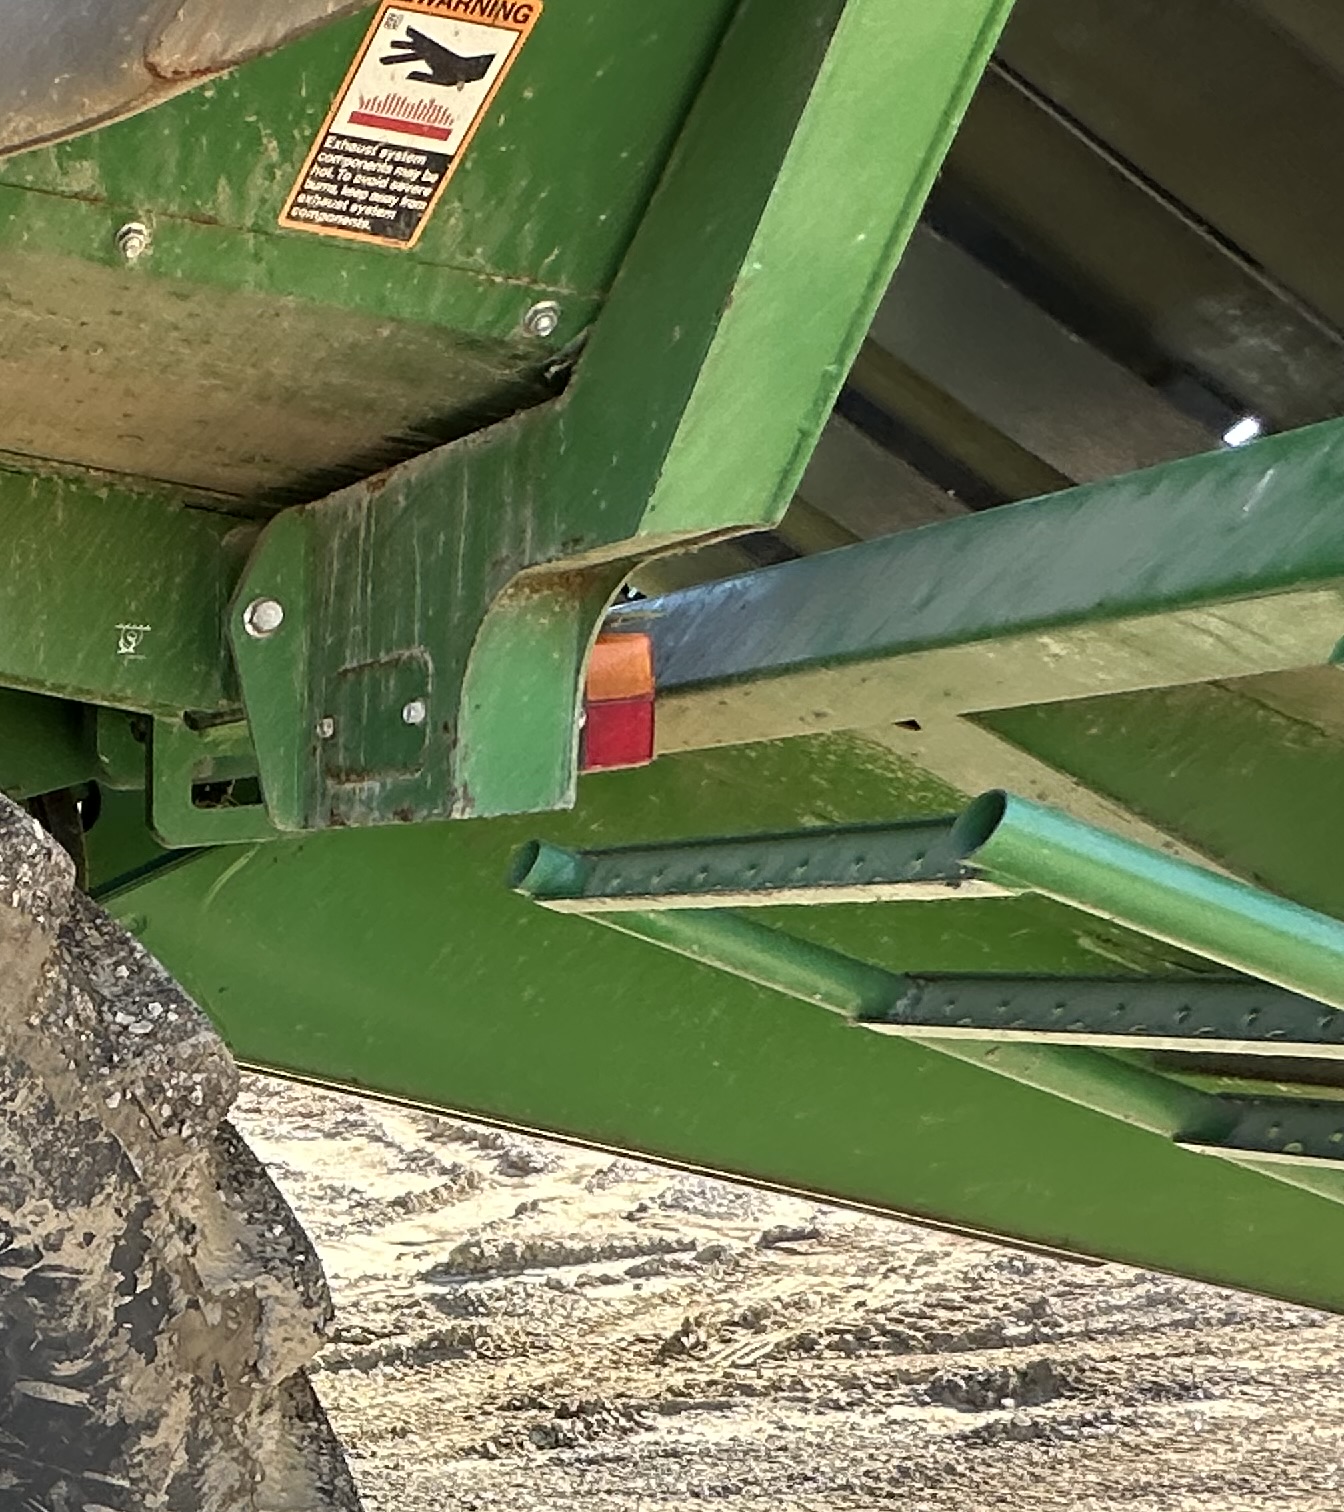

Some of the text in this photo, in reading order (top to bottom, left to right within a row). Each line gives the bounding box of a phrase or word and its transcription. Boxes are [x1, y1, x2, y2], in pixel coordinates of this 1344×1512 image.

[323, 134, 428, 165] Exhaust system
[316, 151, 440, 183] components may be
[337, 168, 352, 181] To
[353, 174, 390, 188] avoid
[389, 180, 433, 197] severe
[340, 184, 369, 201] keep
[368, 192, 400, 208] away
[399, 195, 428, 210] from
[296, 193, 398, 220] exhaust system
